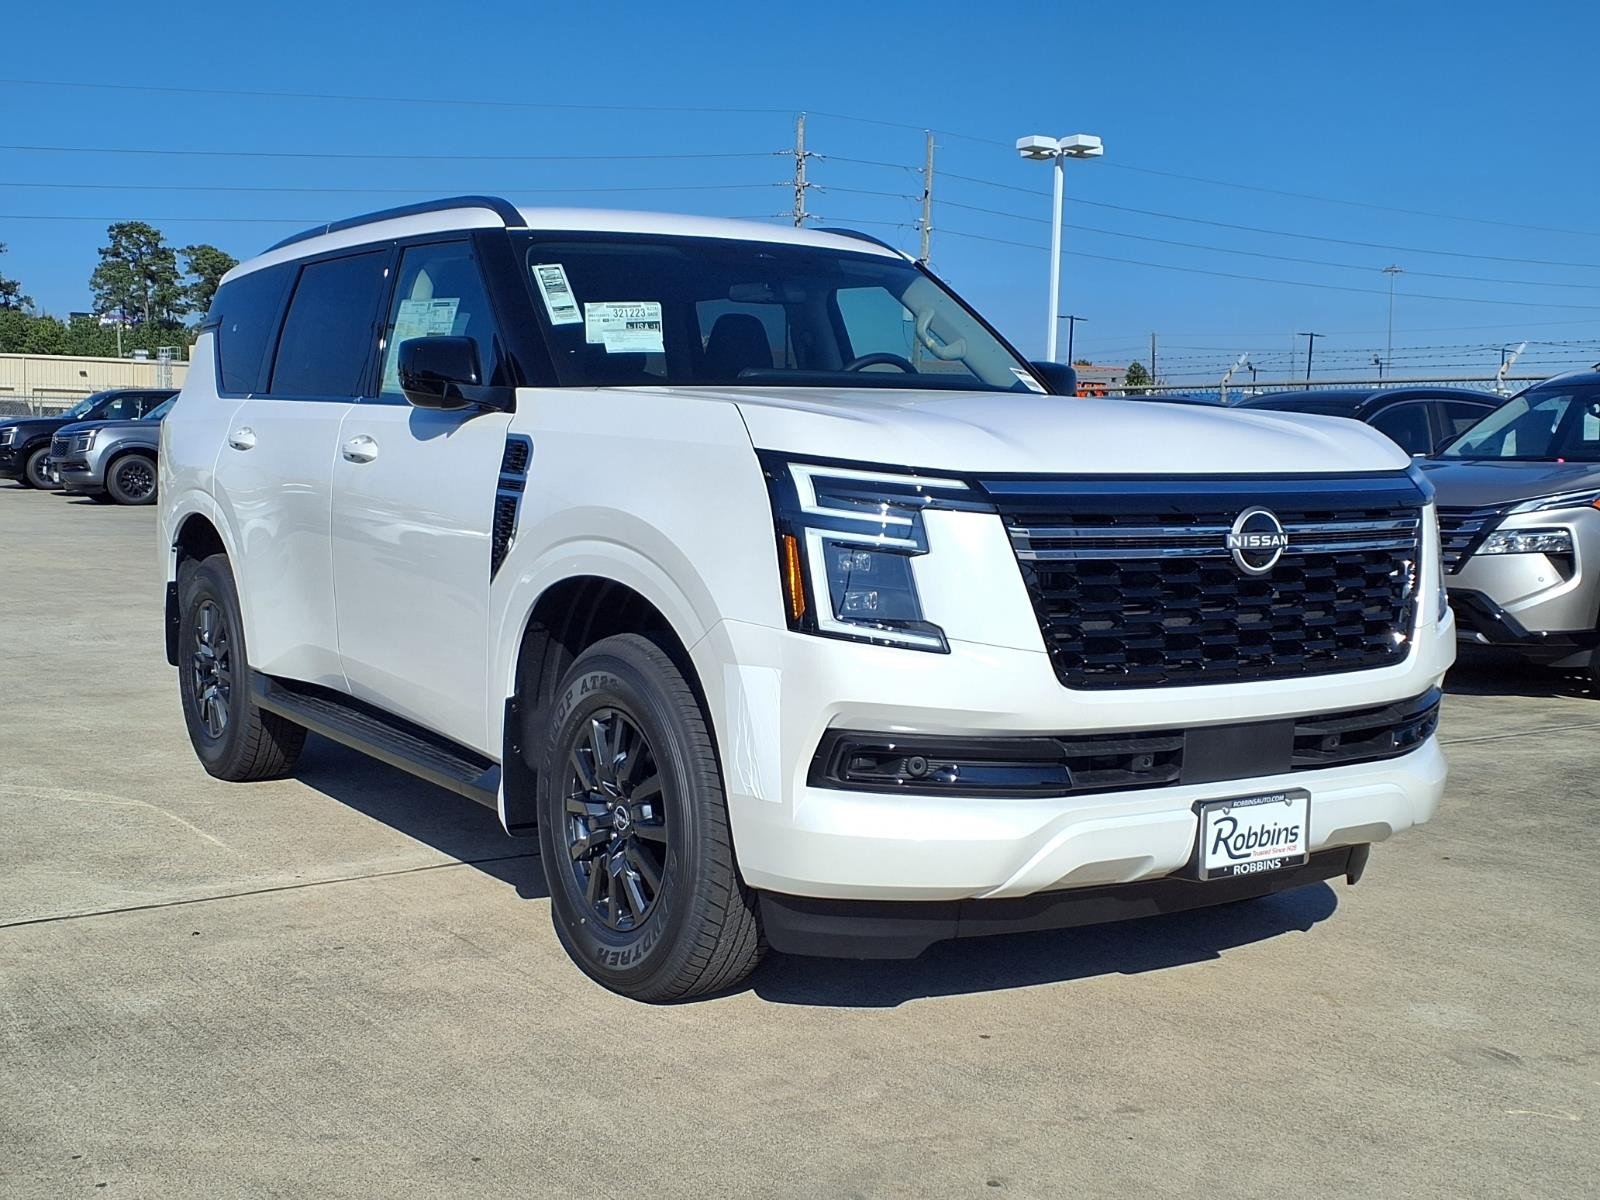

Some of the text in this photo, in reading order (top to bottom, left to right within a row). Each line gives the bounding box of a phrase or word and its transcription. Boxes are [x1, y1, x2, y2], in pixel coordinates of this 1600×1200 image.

[613, 308, 646, 318] 321223
[1229, 534, 1289, 547] NISSAN
[1211, 816, 1300, 860] Robbins
[1233, 858, 1282, 875] ROBBINS
